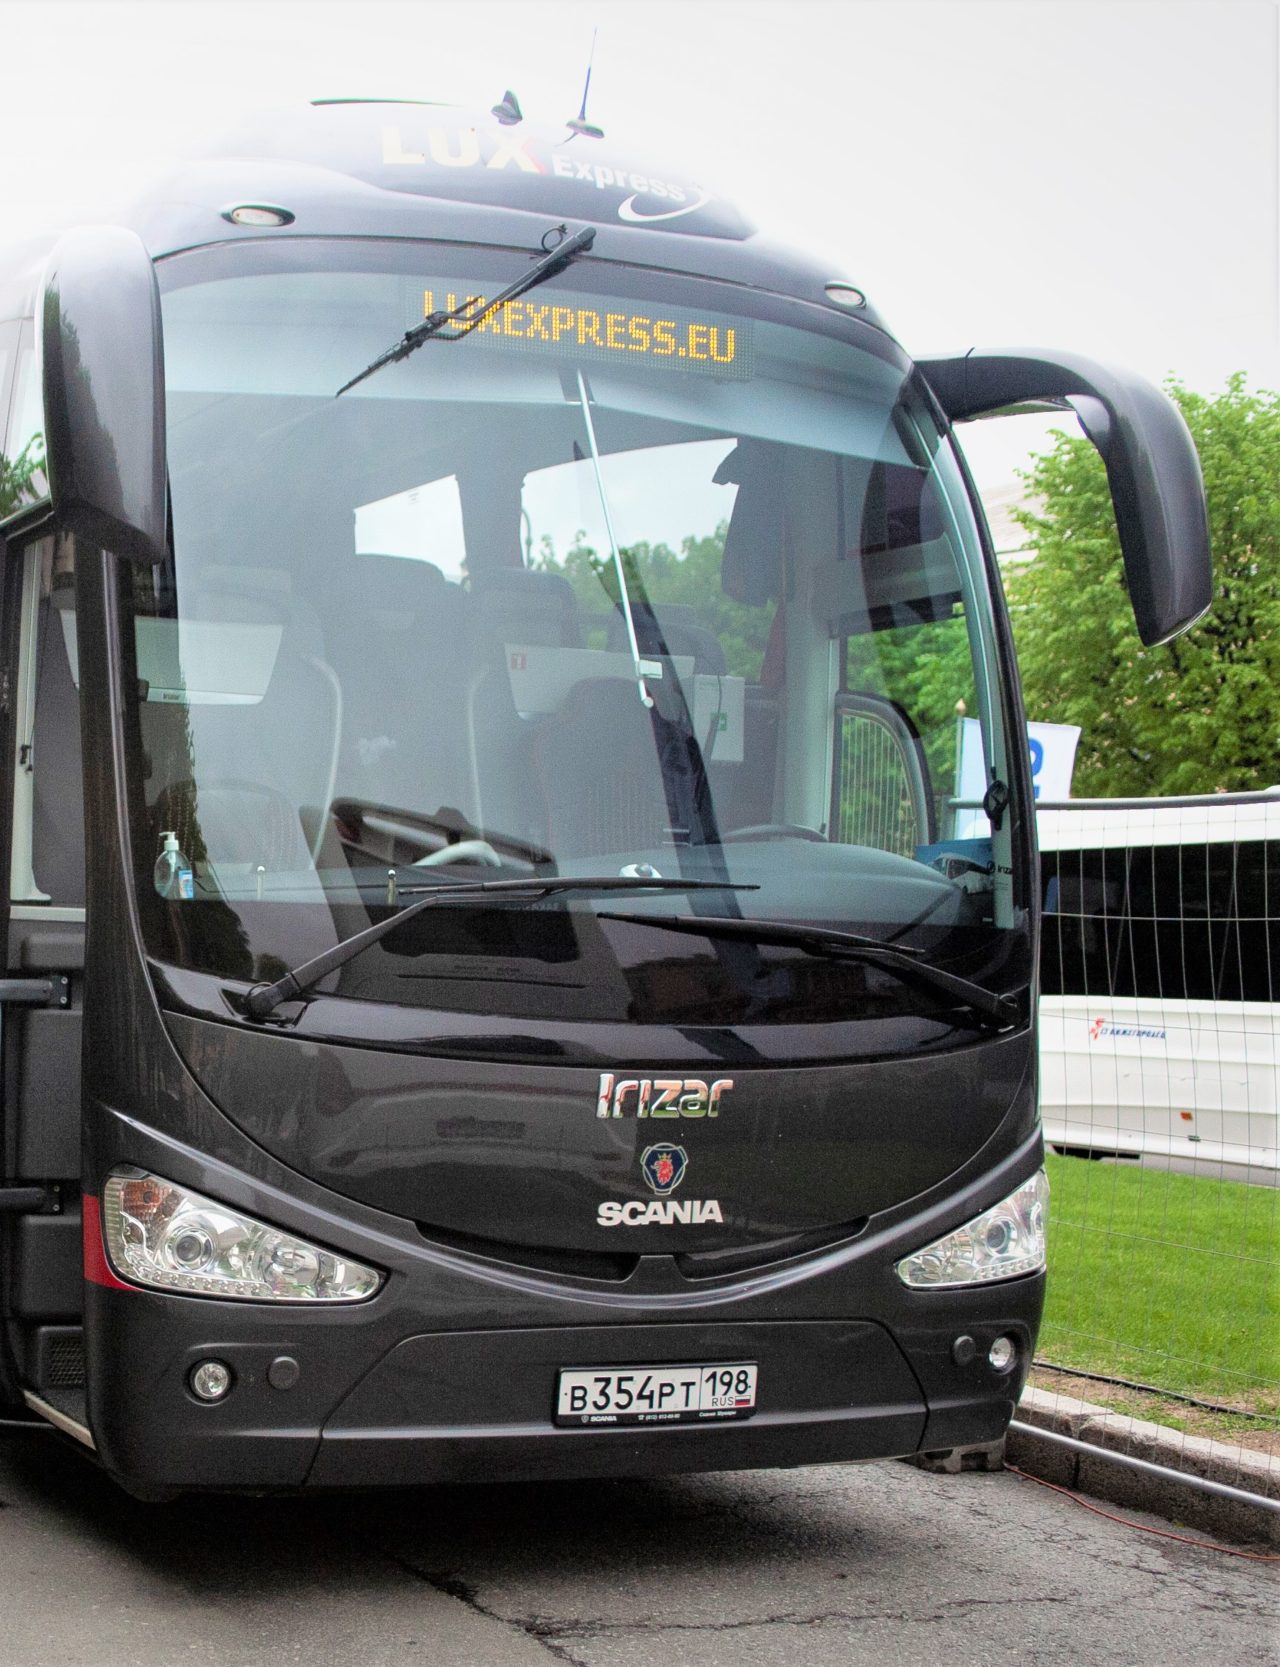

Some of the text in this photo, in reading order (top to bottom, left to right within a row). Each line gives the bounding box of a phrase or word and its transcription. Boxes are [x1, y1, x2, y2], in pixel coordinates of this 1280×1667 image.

[381, 125, 688, 202] LUX Express
[596, 1073, 734, 1118] Irizar
[596, 1200, 724, 1226] SCANIA
[704, 1369, 750, 1397] 198
[711, 1396, 734, 1407] RUS
